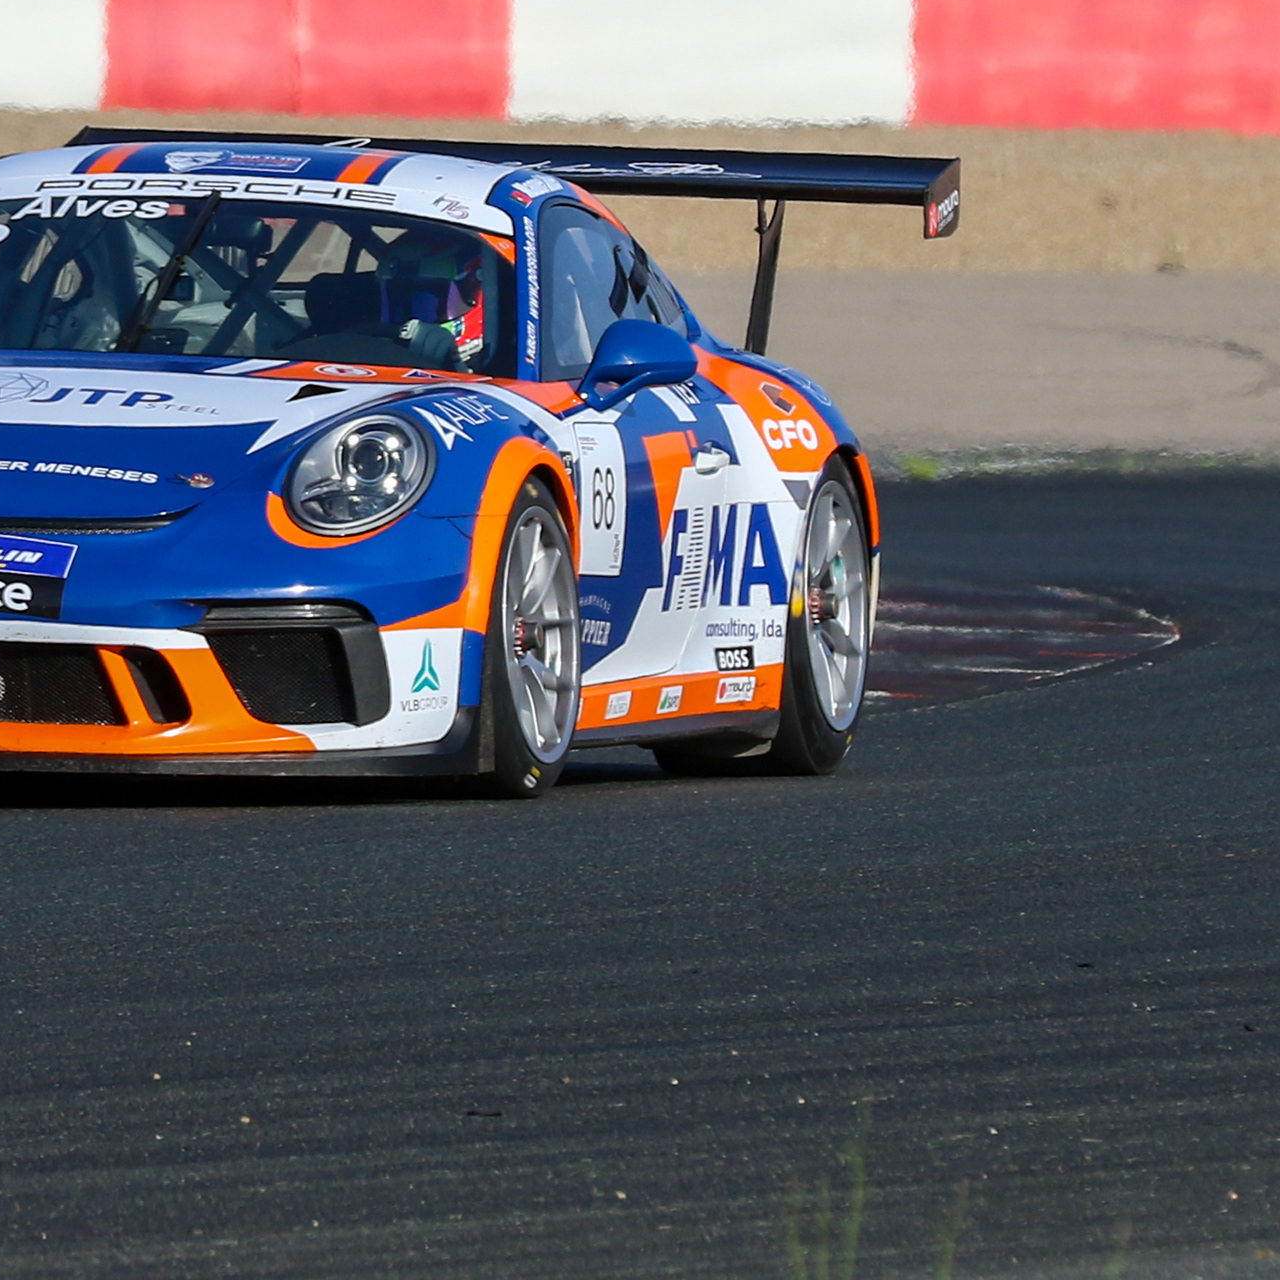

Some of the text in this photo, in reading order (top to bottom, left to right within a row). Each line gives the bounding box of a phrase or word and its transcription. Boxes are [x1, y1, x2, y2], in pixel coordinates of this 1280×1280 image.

[10, 190, 170, 219] Alves
[36, 178, 397, 206] PORSCHE
[29, 387, 176, 408] JTP
[762, 418, 819, 451] CFO
[32, 461, 160, 485] MENESES
[592, 467, 616, 531] 68
[718, 649, 750, 670] BOSS
